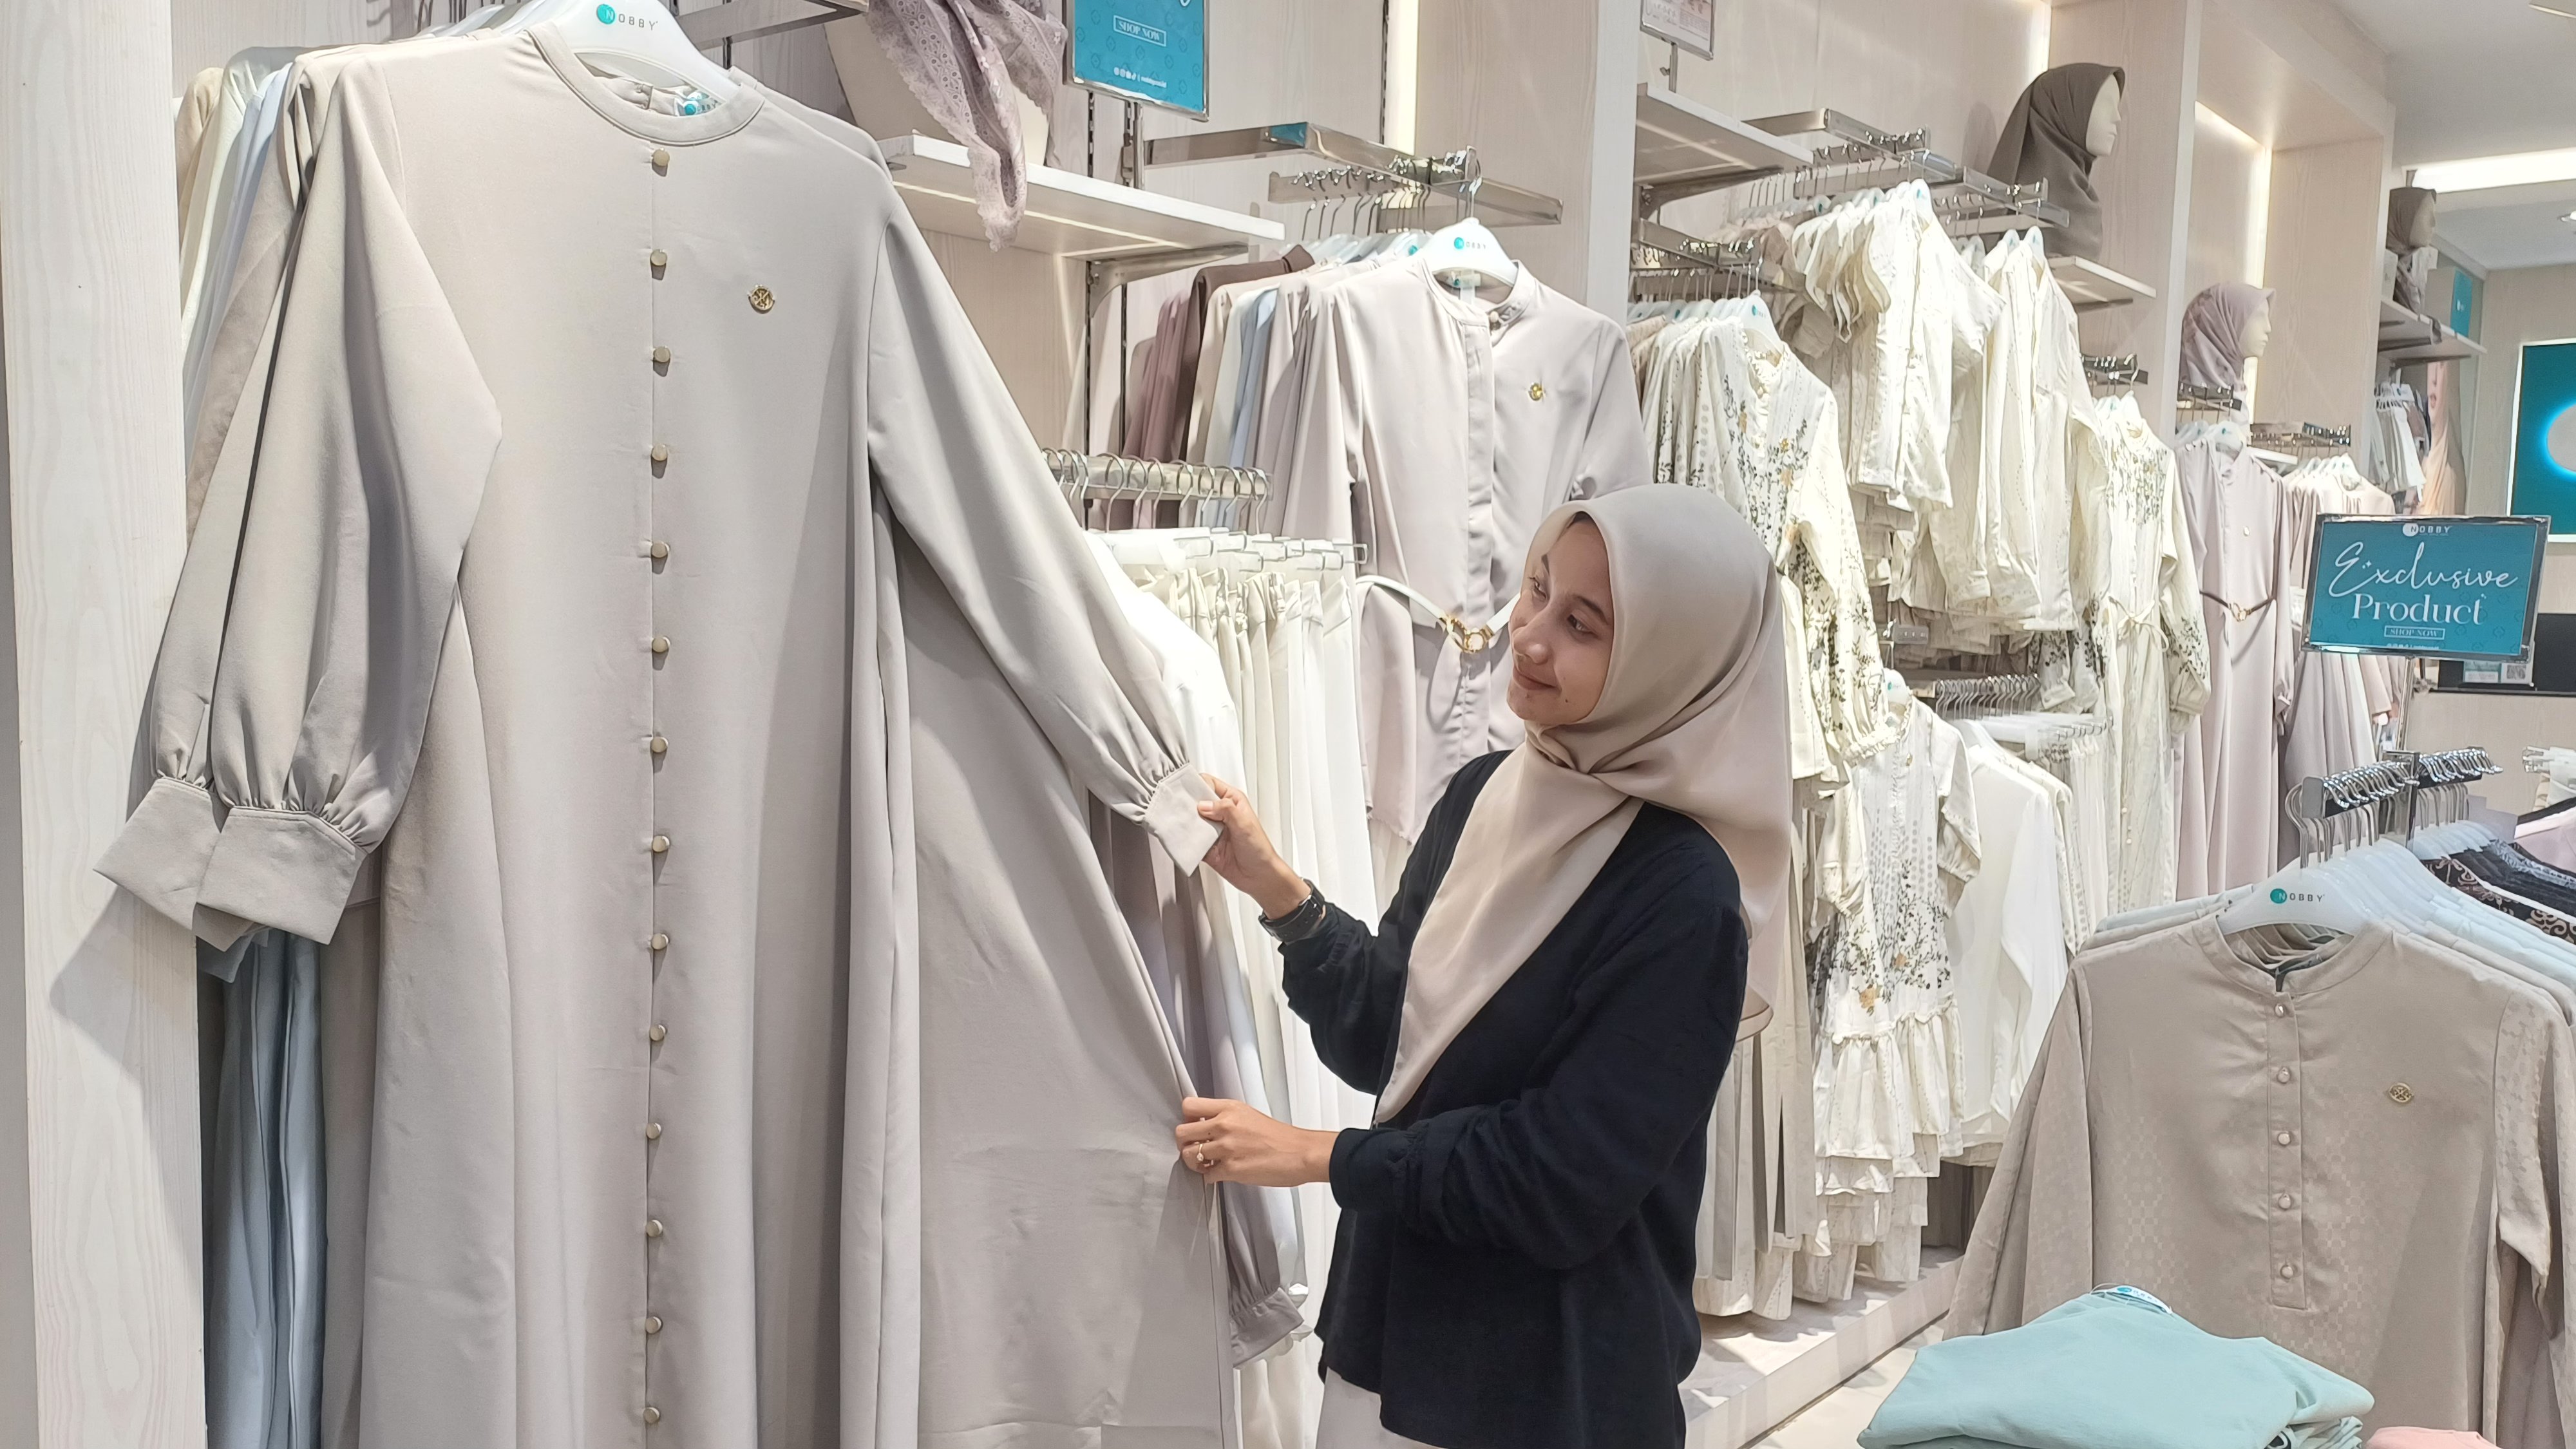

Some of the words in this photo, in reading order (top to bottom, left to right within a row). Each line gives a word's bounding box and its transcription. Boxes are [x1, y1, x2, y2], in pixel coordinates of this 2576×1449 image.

[604, 8, 656, 31] NOBBY
[1118, 20, 1141, 35] SHOP
[1142, 28, 1160, 41] NOW
[2409, 524, 2451, 534] NOBBY
[2329, 542, 2519, 597] Exclusive
[2351, 592, 2485, 625] Product
[2390, 628, 2415, 636] SHOP
[2277, 891, 2323, 902] NOBBY
